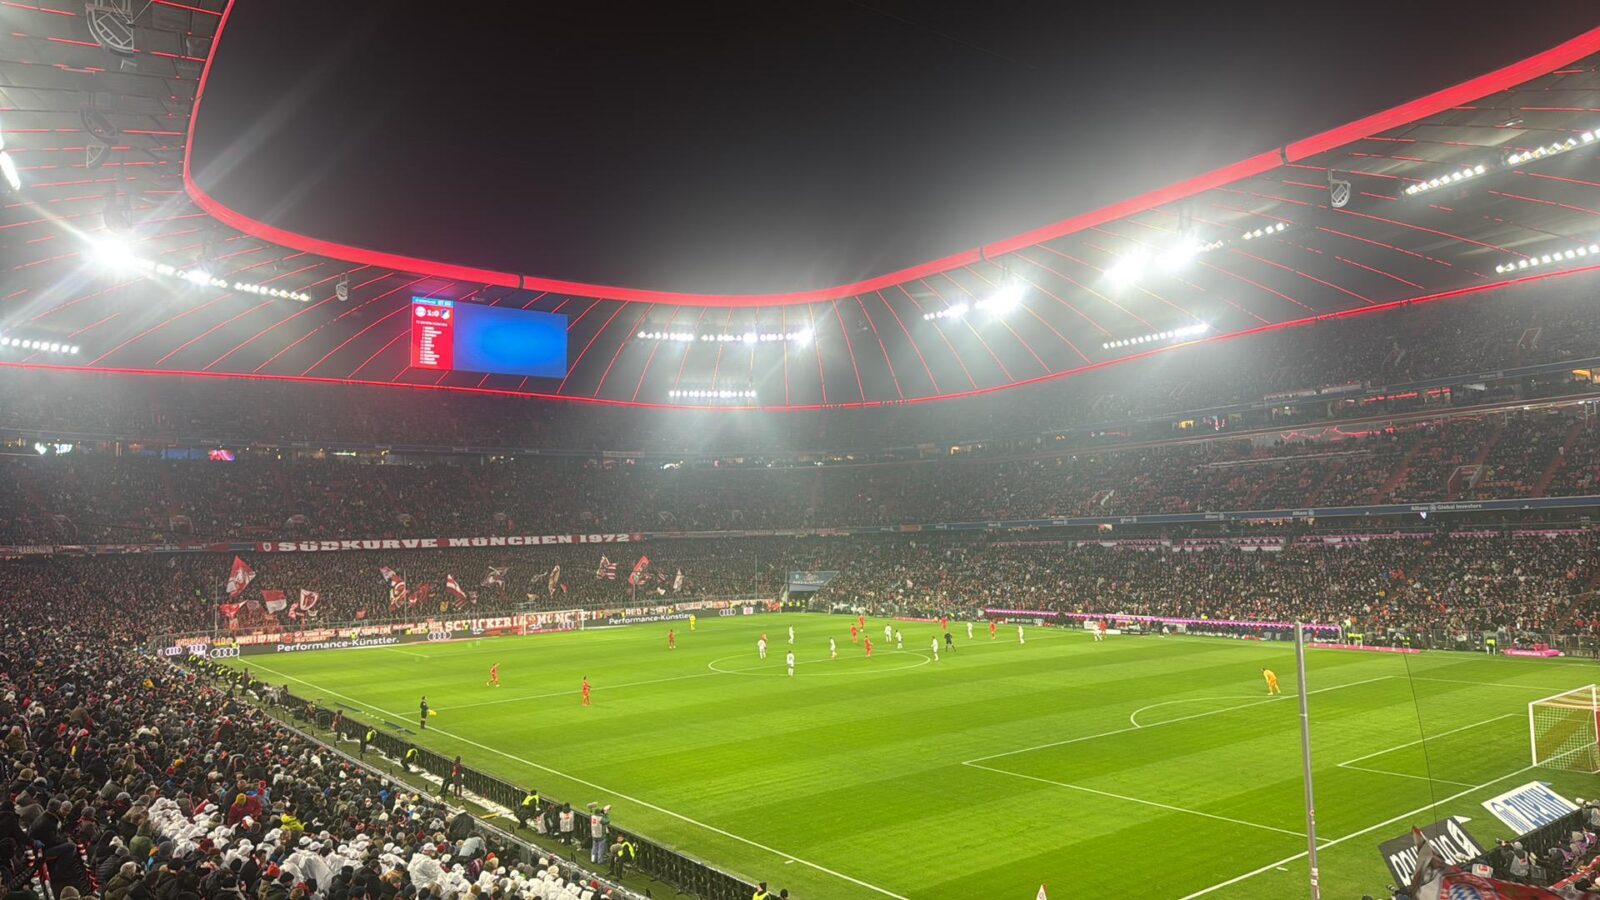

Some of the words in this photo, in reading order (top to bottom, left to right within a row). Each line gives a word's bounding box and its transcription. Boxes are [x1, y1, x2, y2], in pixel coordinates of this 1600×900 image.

[278, 538, 438, 552] SÜDKURVE
[449, 534, 573, 548] MÜNCHEN
[580, 533, 630, 543] 1972
[277, 637, 400, 652] Performance-Künstler.
